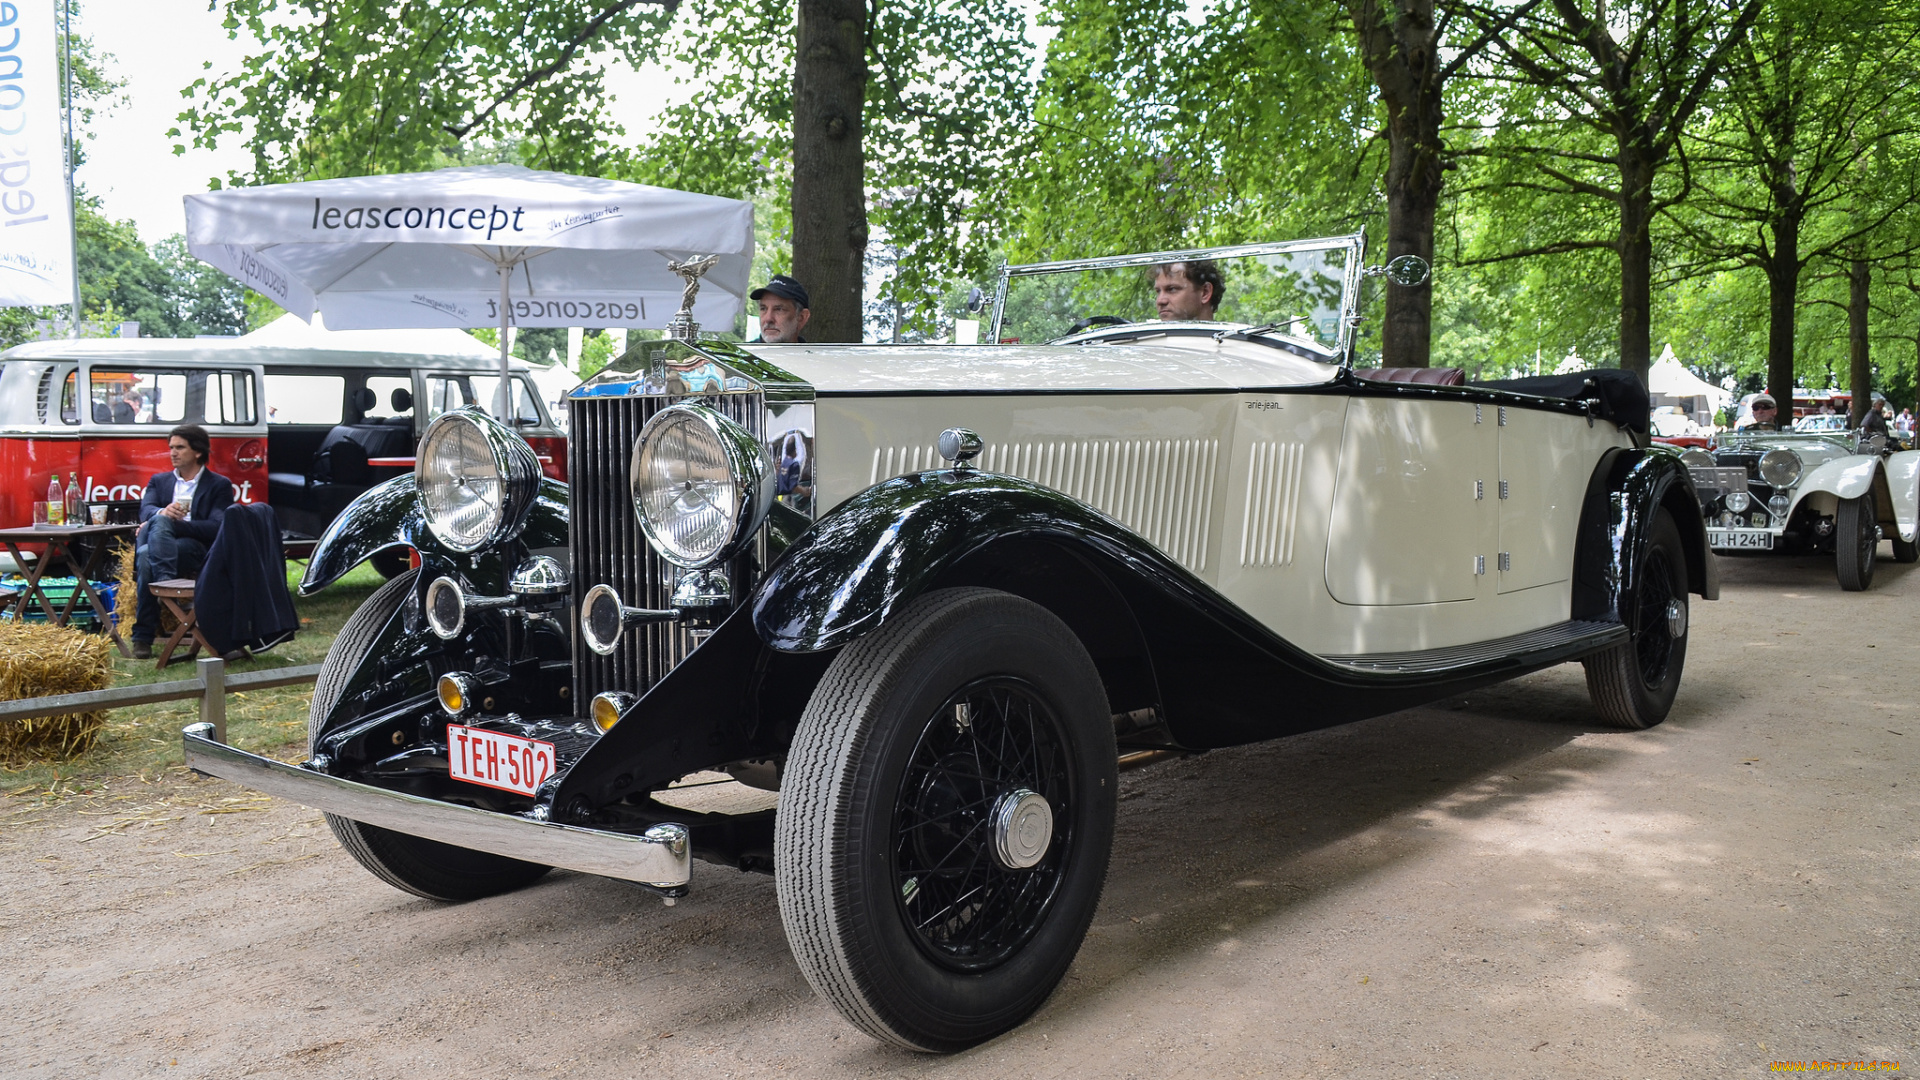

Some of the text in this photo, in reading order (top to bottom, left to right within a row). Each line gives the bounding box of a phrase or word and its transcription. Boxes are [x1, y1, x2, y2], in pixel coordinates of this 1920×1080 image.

[312, 198, 525, 240] leasconcept
[1727, 533, 1737, 546] H
[1740, 533, 1767, 547] 24H
